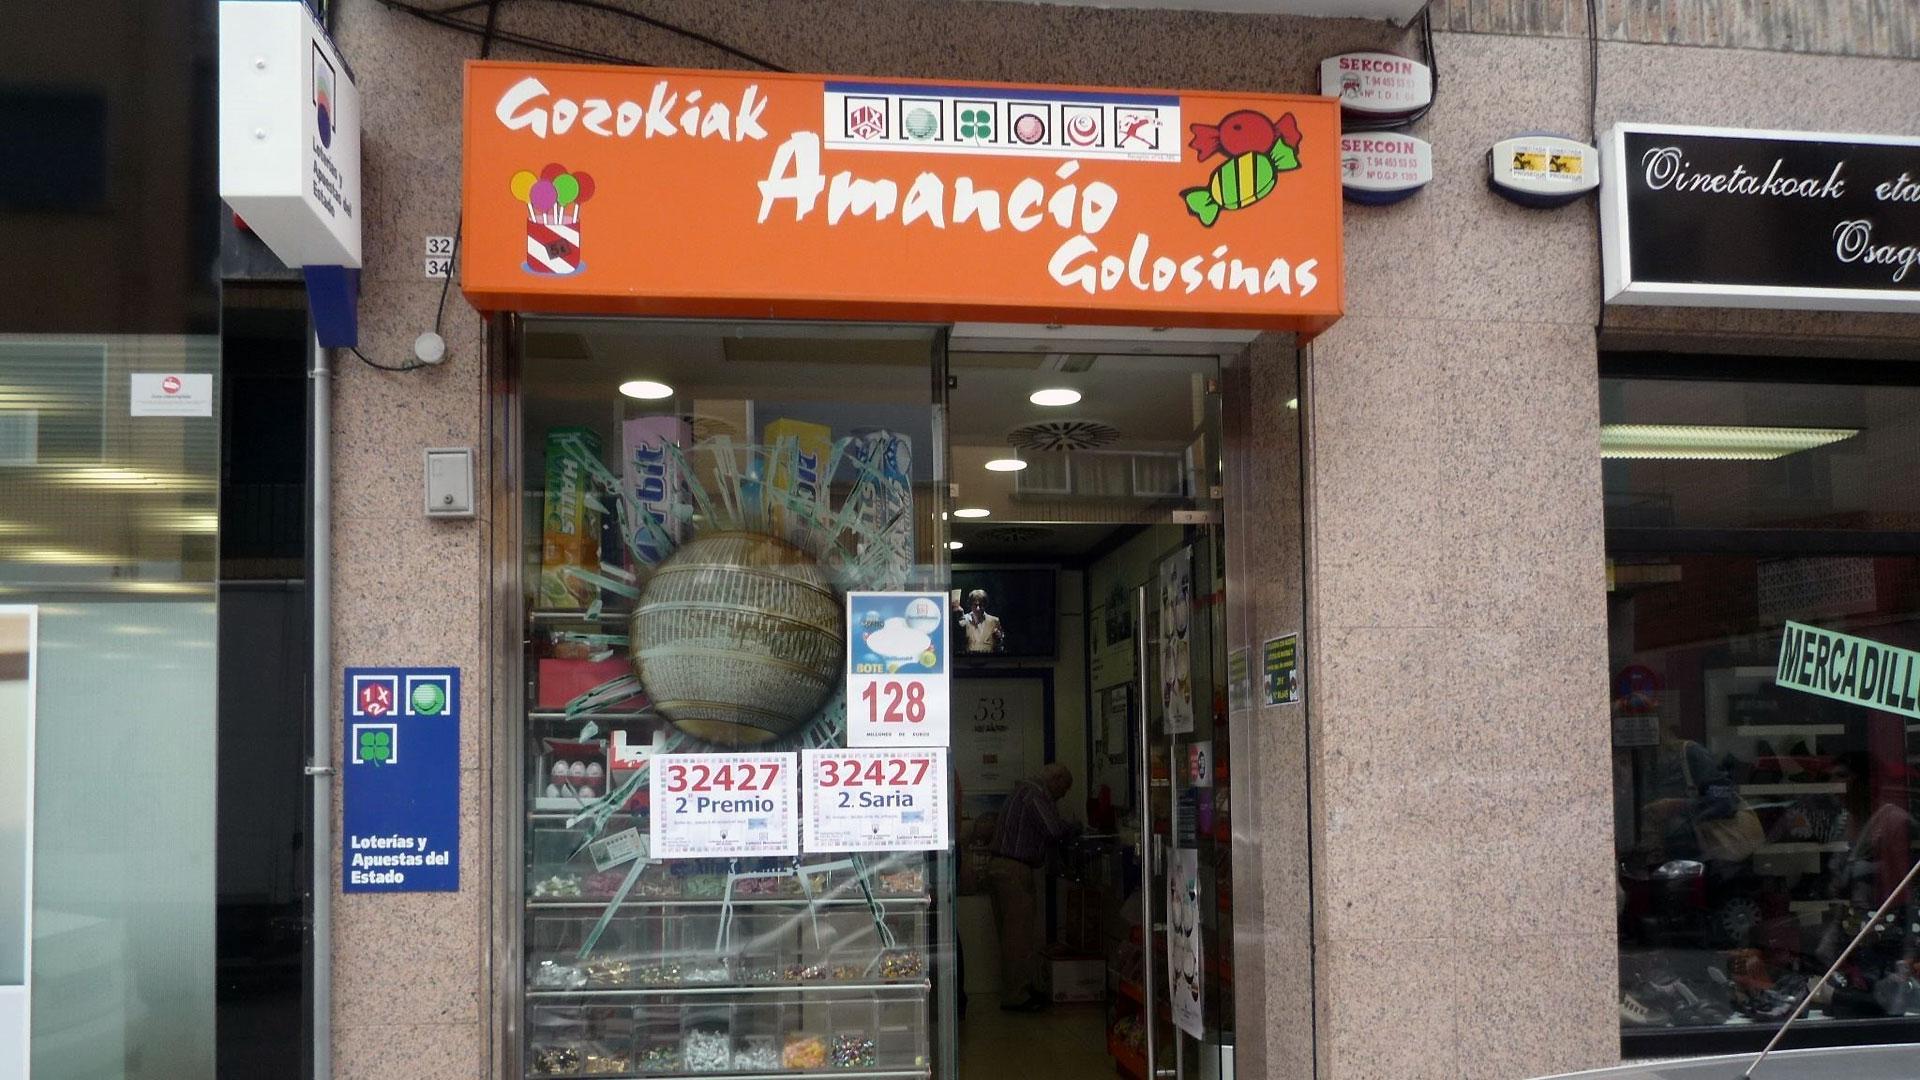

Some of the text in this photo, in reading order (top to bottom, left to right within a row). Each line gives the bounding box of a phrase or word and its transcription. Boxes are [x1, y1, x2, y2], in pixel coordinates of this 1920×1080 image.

[1339, 57, 1412, 74] SERCOIN
[495, 77, 768, 142] Gozokiak
[1341, 139, 1414, 154] SERCOIN
[1641, 147, 1846, 199] Oinetakoak
[756, 131, 1118, 234] Amancio
[428, 238, 451, 254] 32
[428, 260, 450, 276] 34
[1047, 233, 1319, 297] Golosinas
[856, 663, 884, 673] BOTE
[1779, 627, 1920, 712] MERCADILL
[862, 681, 926, 723] 128
[667, 764, 780, 792] 32427
[819, 760, 930, 787] 32427
[697, 796, 774, 814] Premio
[859, 790, 914, 808] Saria
[351, 834, 427, 851] Loterías y
[352, 851, 449, 869] Apuestas del
[351, 870, 404, 884] Estado
